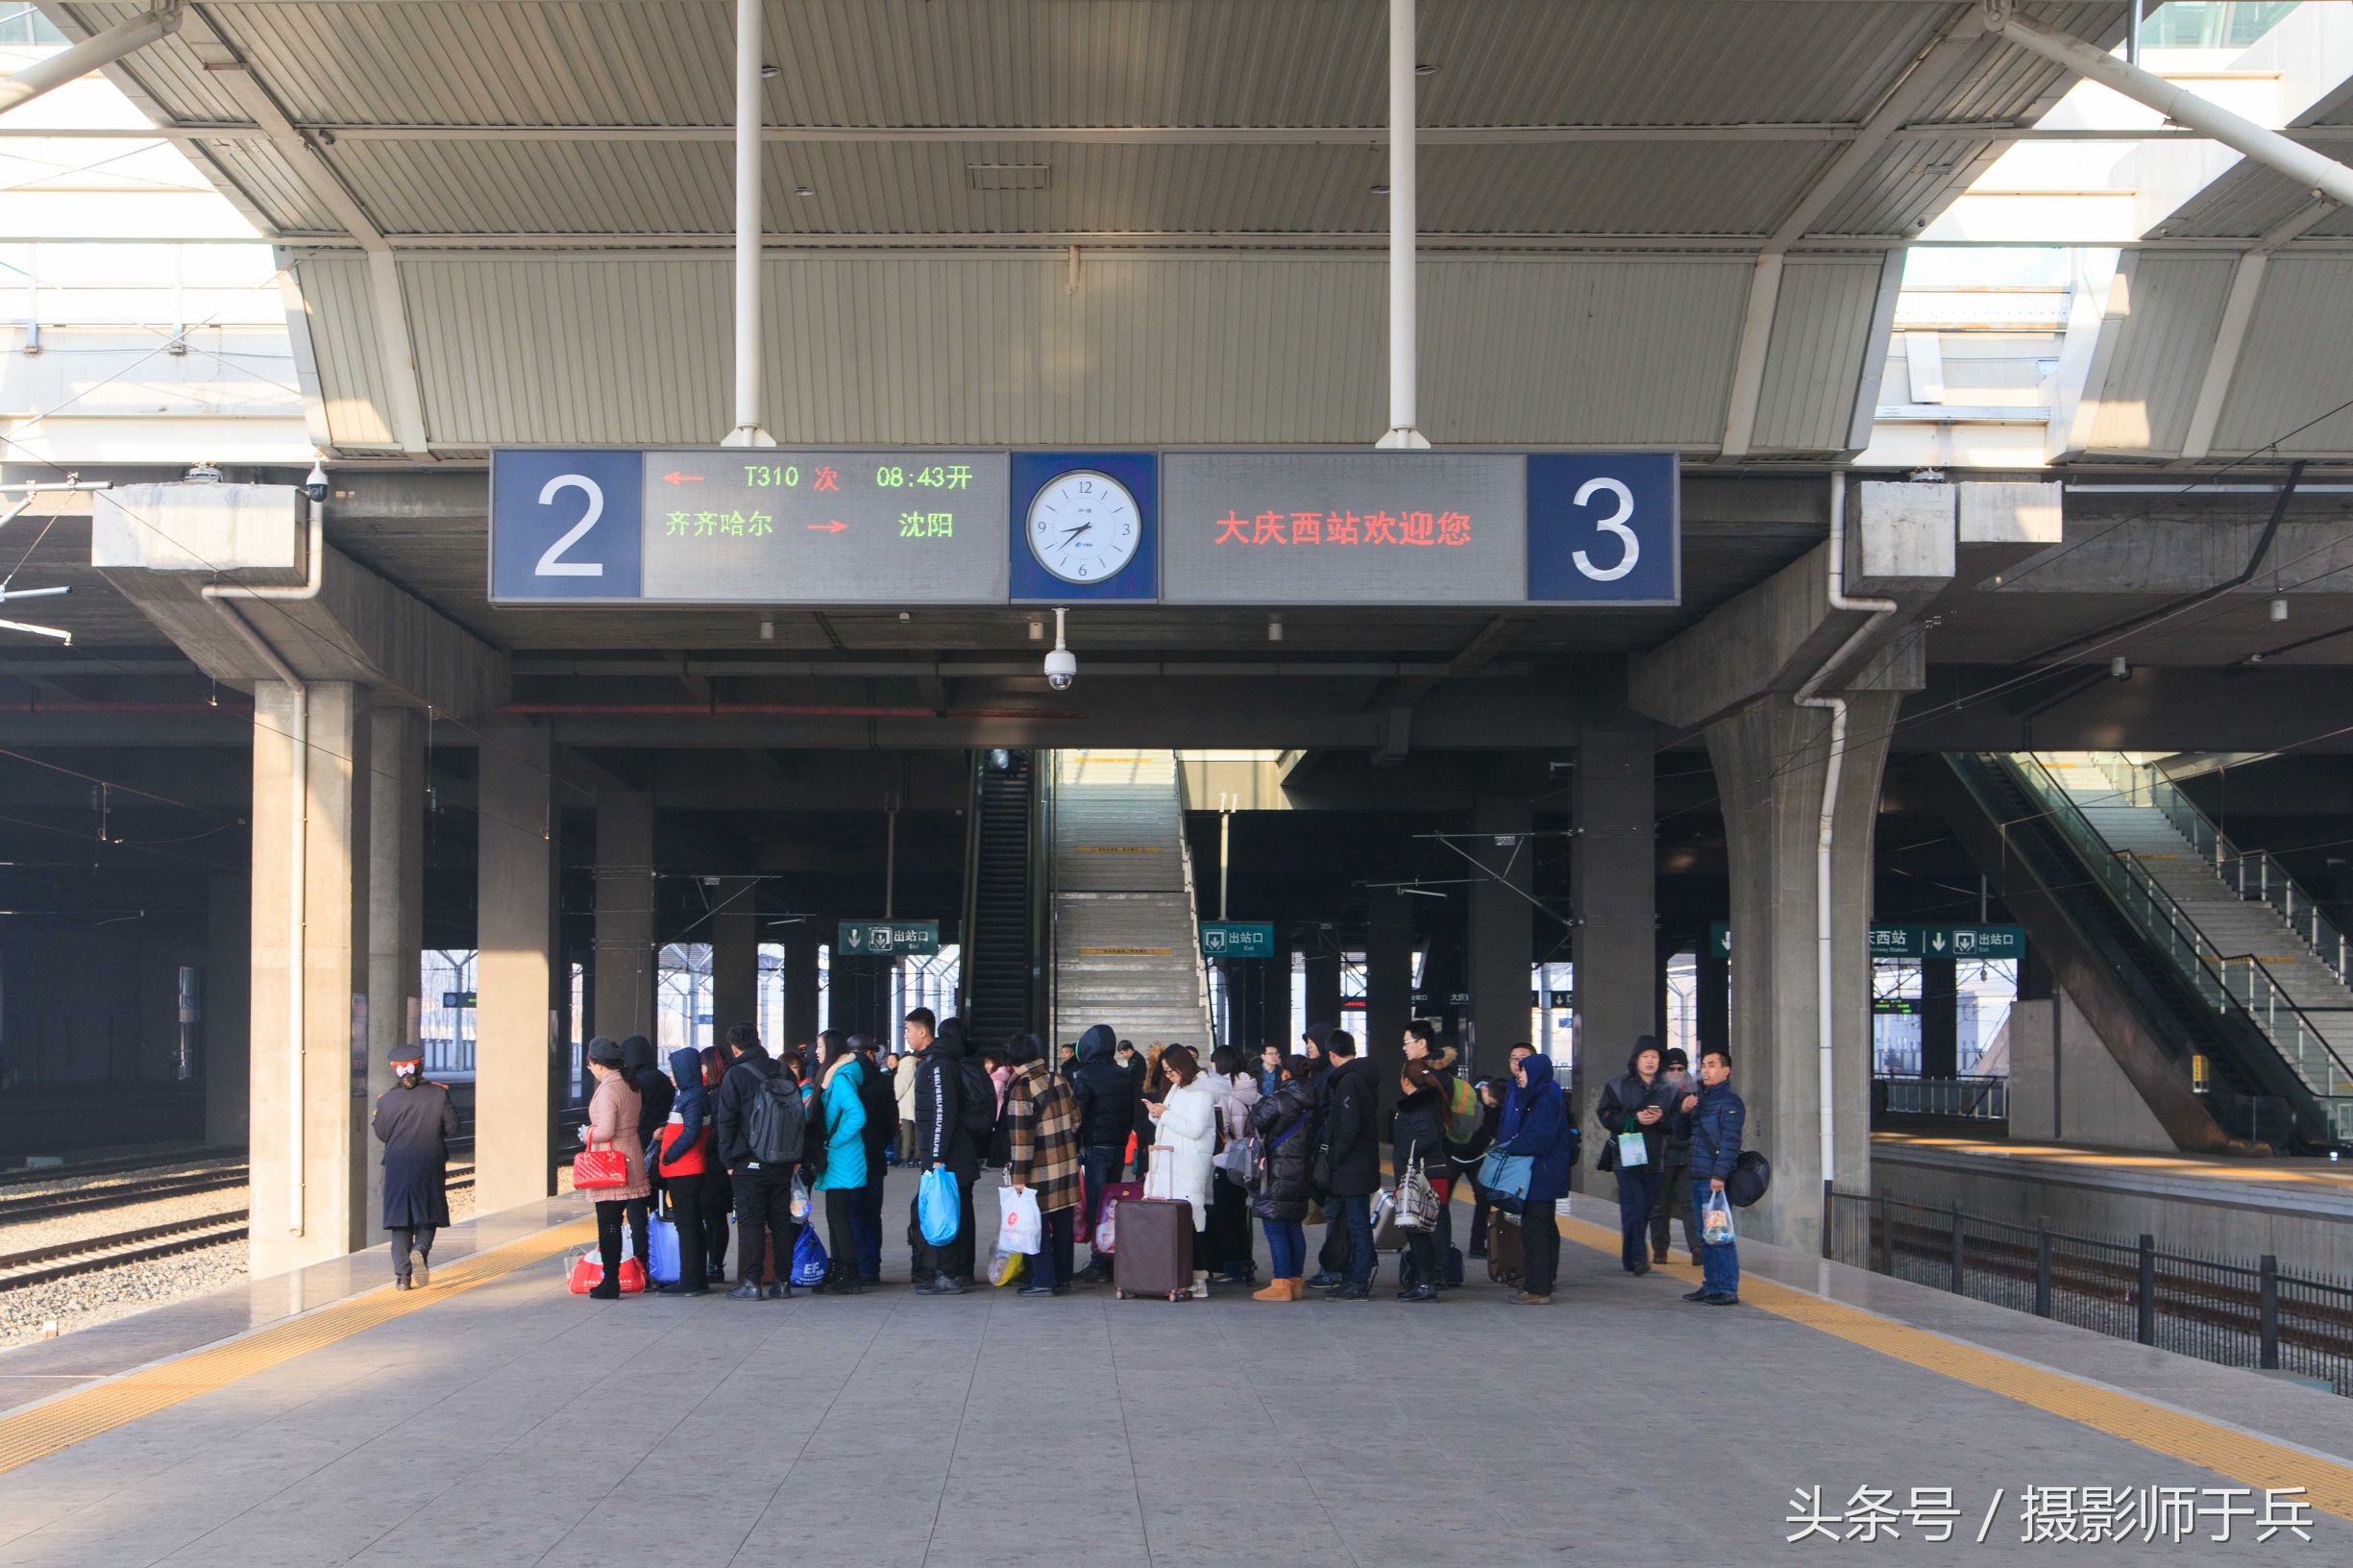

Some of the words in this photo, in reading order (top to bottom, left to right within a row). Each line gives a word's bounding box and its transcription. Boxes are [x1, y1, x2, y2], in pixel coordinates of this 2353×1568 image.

[745, 466, 799, 487] T310
[814, 467, 841, 492] 次
[876, 466, 973, 489] 08:43开
[1078, 481, 1092, 493] 12
[534, 474, 603, 576] 2
[666, 510, 773, 537] 齐齐哈尔
[899, 511, 954, 538] 沈阳
[1038, 522, 1046, 534] 9
[1122, 524, 1131, 535] 3
[1214, 509, 1472, 546] 大庆西站欢迎您
[1571, 478, 1639, 581] 3
[1078, 564, 1088, 576] 6
[894, 930, 929, 943] 出站口
[1229, 932, 1263, 943] 出站口
[1978, 933, 2014, 945] 出站口
